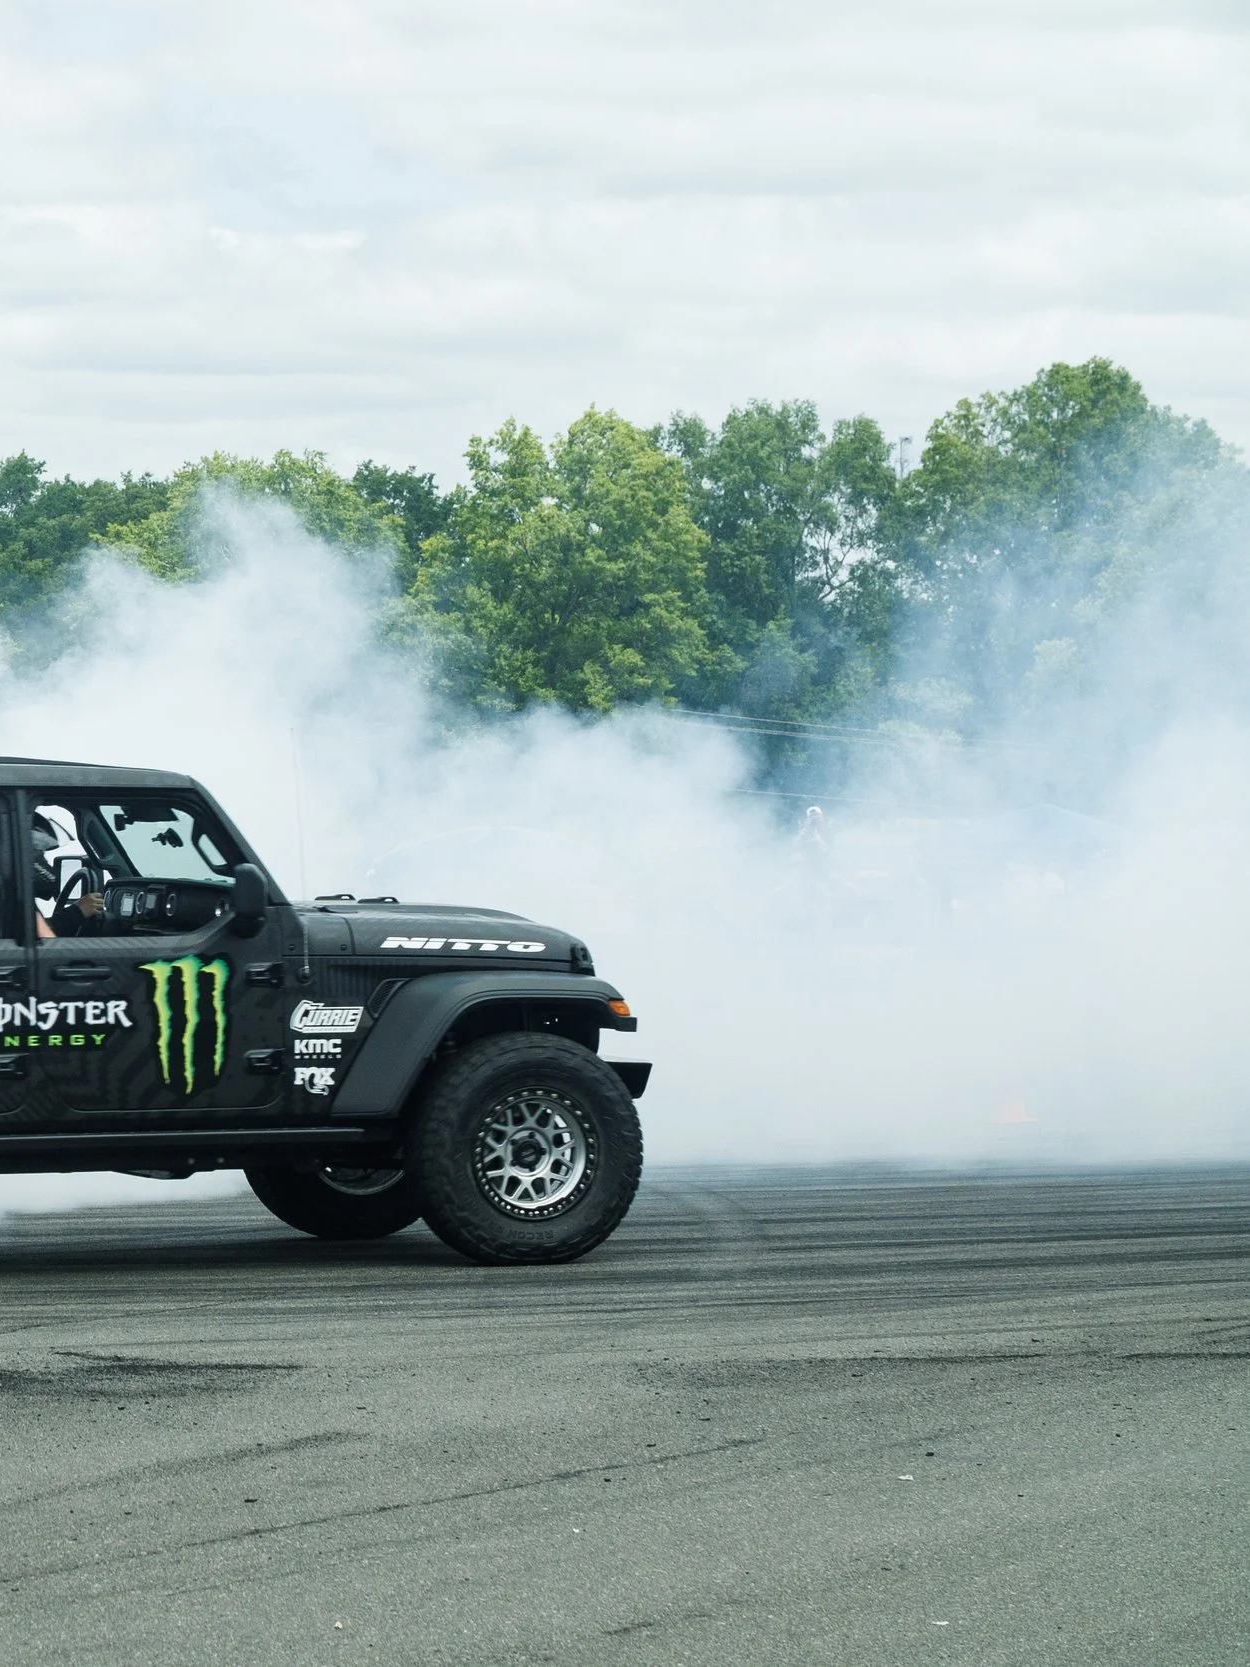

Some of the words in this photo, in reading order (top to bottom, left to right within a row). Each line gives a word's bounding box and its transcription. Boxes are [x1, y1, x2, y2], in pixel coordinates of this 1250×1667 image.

[380, 937, 546, 952] NITTO
[291, 1002, 361, 1030] CURRIE
[294, 1039, 342, 1053] KMC
[294, 1067, 335, 1095] FOX
